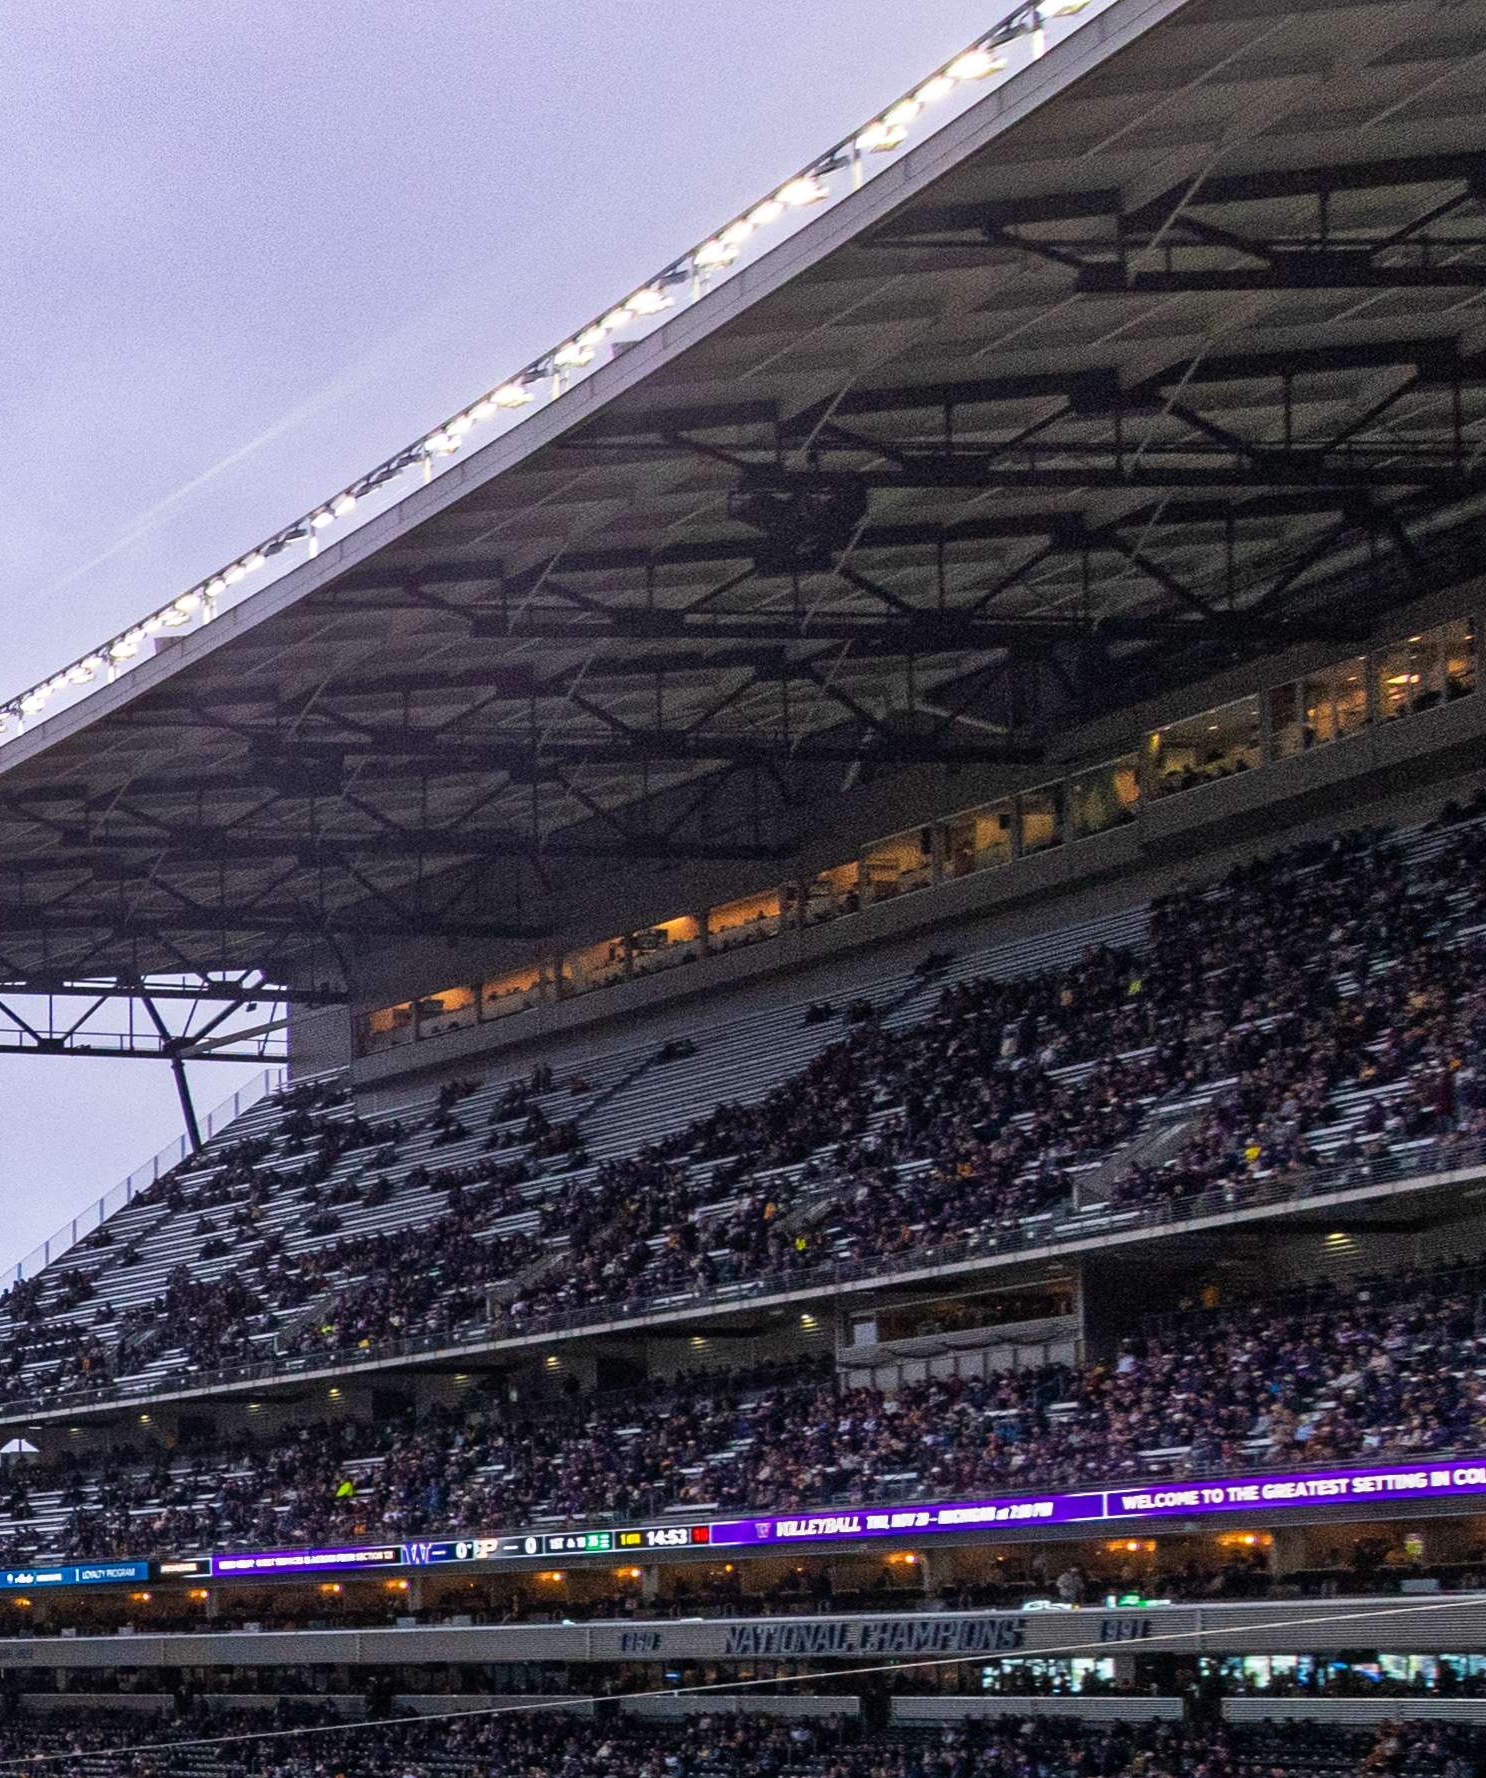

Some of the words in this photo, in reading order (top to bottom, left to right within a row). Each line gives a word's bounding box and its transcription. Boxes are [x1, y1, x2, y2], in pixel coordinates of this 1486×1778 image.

[1122, 1489, 1199, 1511] WELCOME
[1201, 1488, 1223, 1504] TO
[1226, 1486, 1260, 1502] THE
[1262, 1475, 1349, 1500] GREATEST
[1352, 1472, 1428, 1494] SETTING
[1430, 1471, 1450, 1486] IN
[647, 1528, 688, 1546] 14:53
[776, 1516, 861, 1537] VOLLEYBALL
[524, 1537, 537, 1554] 0
[725, 1623, 854, 1655] NATIONAL
[860, 1618, 1027, 1652] CHAMPIONS
